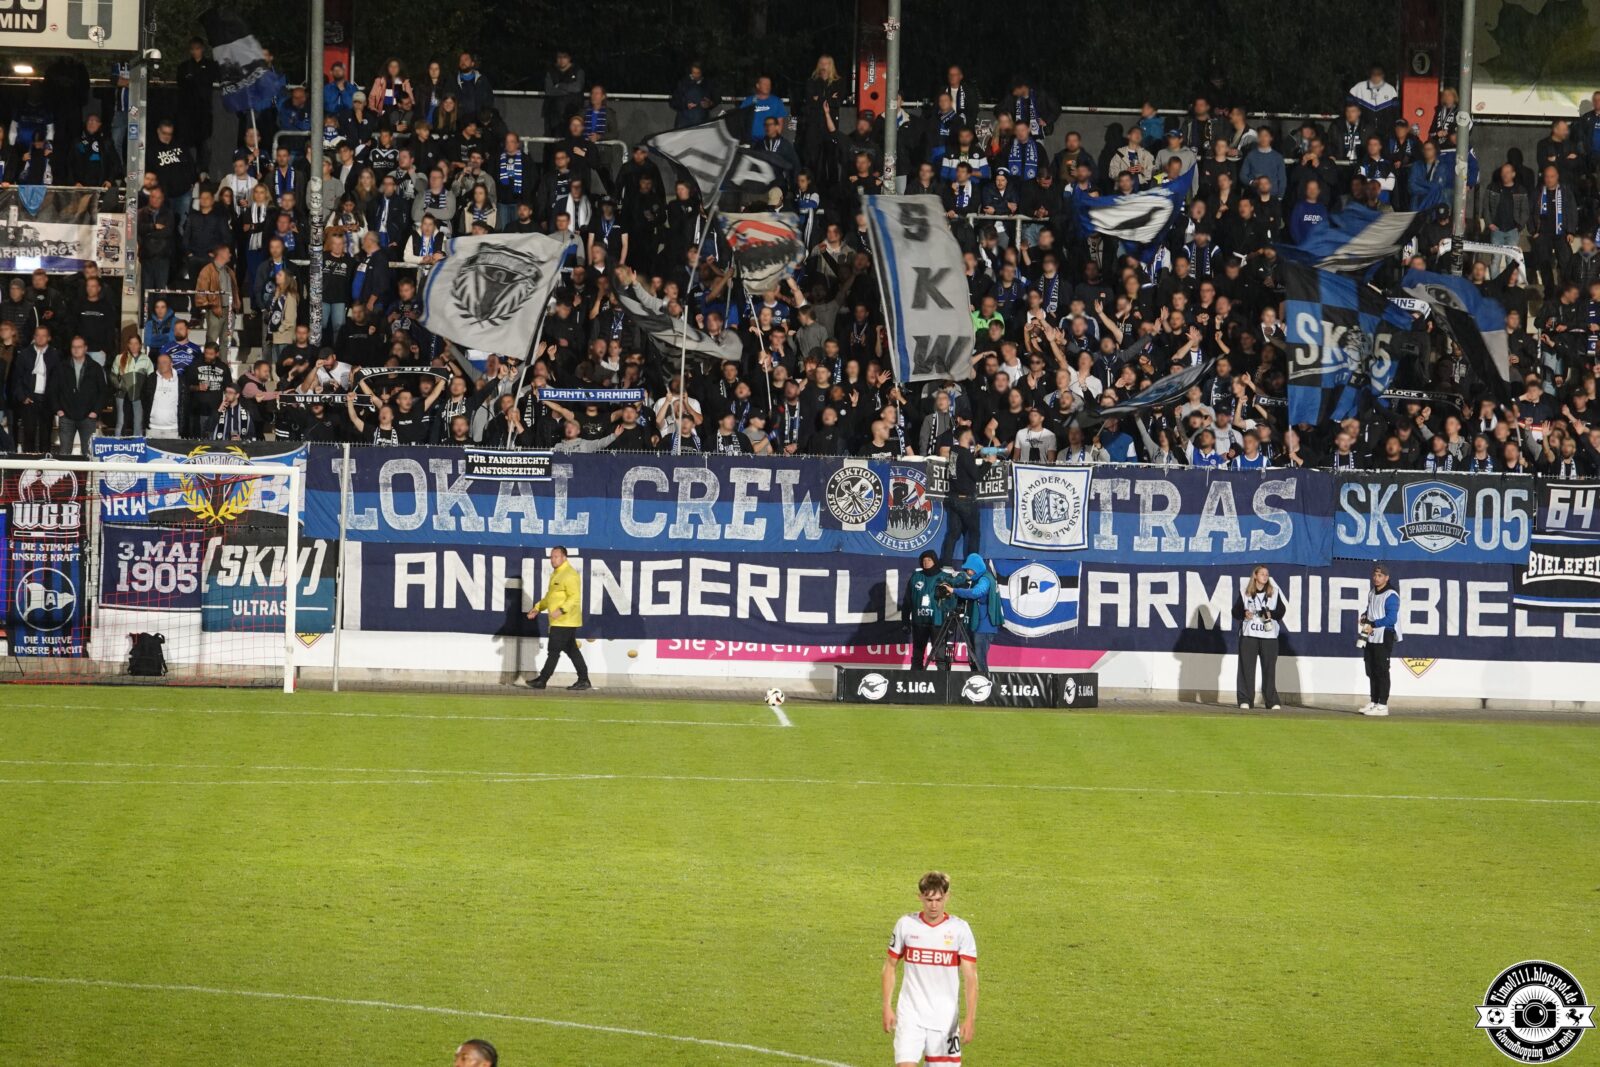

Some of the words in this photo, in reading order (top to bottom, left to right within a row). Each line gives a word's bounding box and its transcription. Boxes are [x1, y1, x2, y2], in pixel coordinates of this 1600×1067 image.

[597, 391, 641, 399] ARMINIA
[467, 454, 486, 463] FÜR
[488, 456, 549, 464] FANGERECHTE
[473, 466, 545, 475] ANSTOSSZEITEN!
[834, 467, 877, 483] SEKTION
[331, 458, 589, 535] LOKAL
[988, 477, 1297, 553] TRAS
[828, 493, 882, 523] STADIONVERBOT
[14, 503, 80, 527] WGB
[1337, 483, 1398, 546] SK
[1474, 488, 1529, 551] 05
[1408, 523, 1462, 538] SPARRENKOLLEKTIV
[21, 543, 36, 551] DIE
[39, 543, 73, 551] STIMME
[876, 532, 927, 550] BIELEFELD
[12, 553, 47, 561] UNSERE
[51, 553, 80, 561] KRAFT
[116, 561, 198, 593] 1905
[232, 600, 288, 616] ULTRAS
[1250, 623, 1265, 631] CLU
[24, 636, 39, 644] DIE
[41, 636, 72, 644] KURVE
[14, 646, 50, 654] UNSERE
[52, 646, 83, 654] MACHT
[866, 642, 968, 656] drun
[908, 682, 935, 694] LIGA
[1012, 685, 1039, 697] LIGA
[947, 1036, 960, 1054] 20
